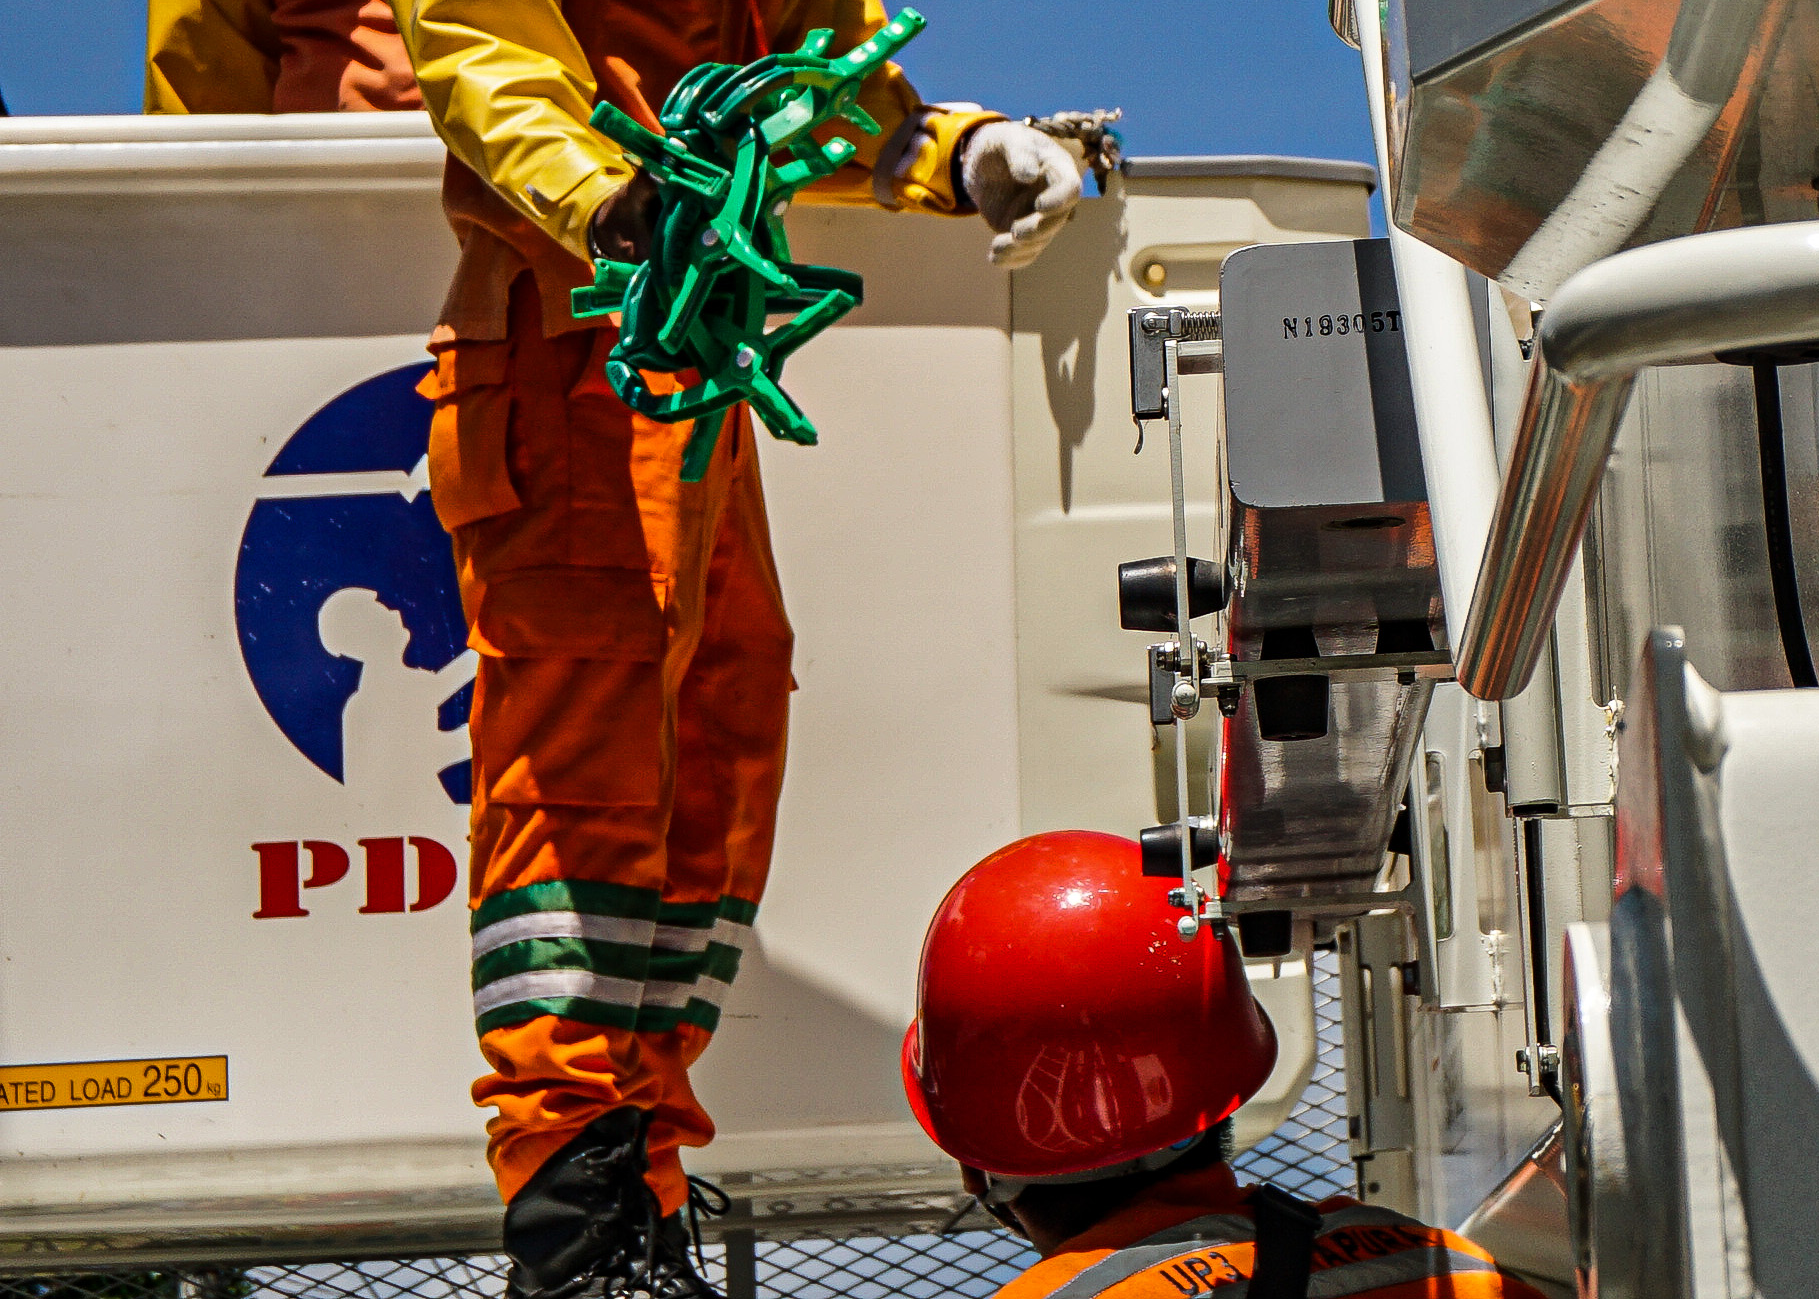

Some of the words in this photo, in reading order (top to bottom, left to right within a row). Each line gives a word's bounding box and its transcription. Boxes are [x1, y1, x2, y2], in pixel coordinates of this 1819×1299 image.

[250, 835, 471, 919] PD
[70, 1076, 132, 1101] LOAD
[143, 1063, 202, 1097] 250
